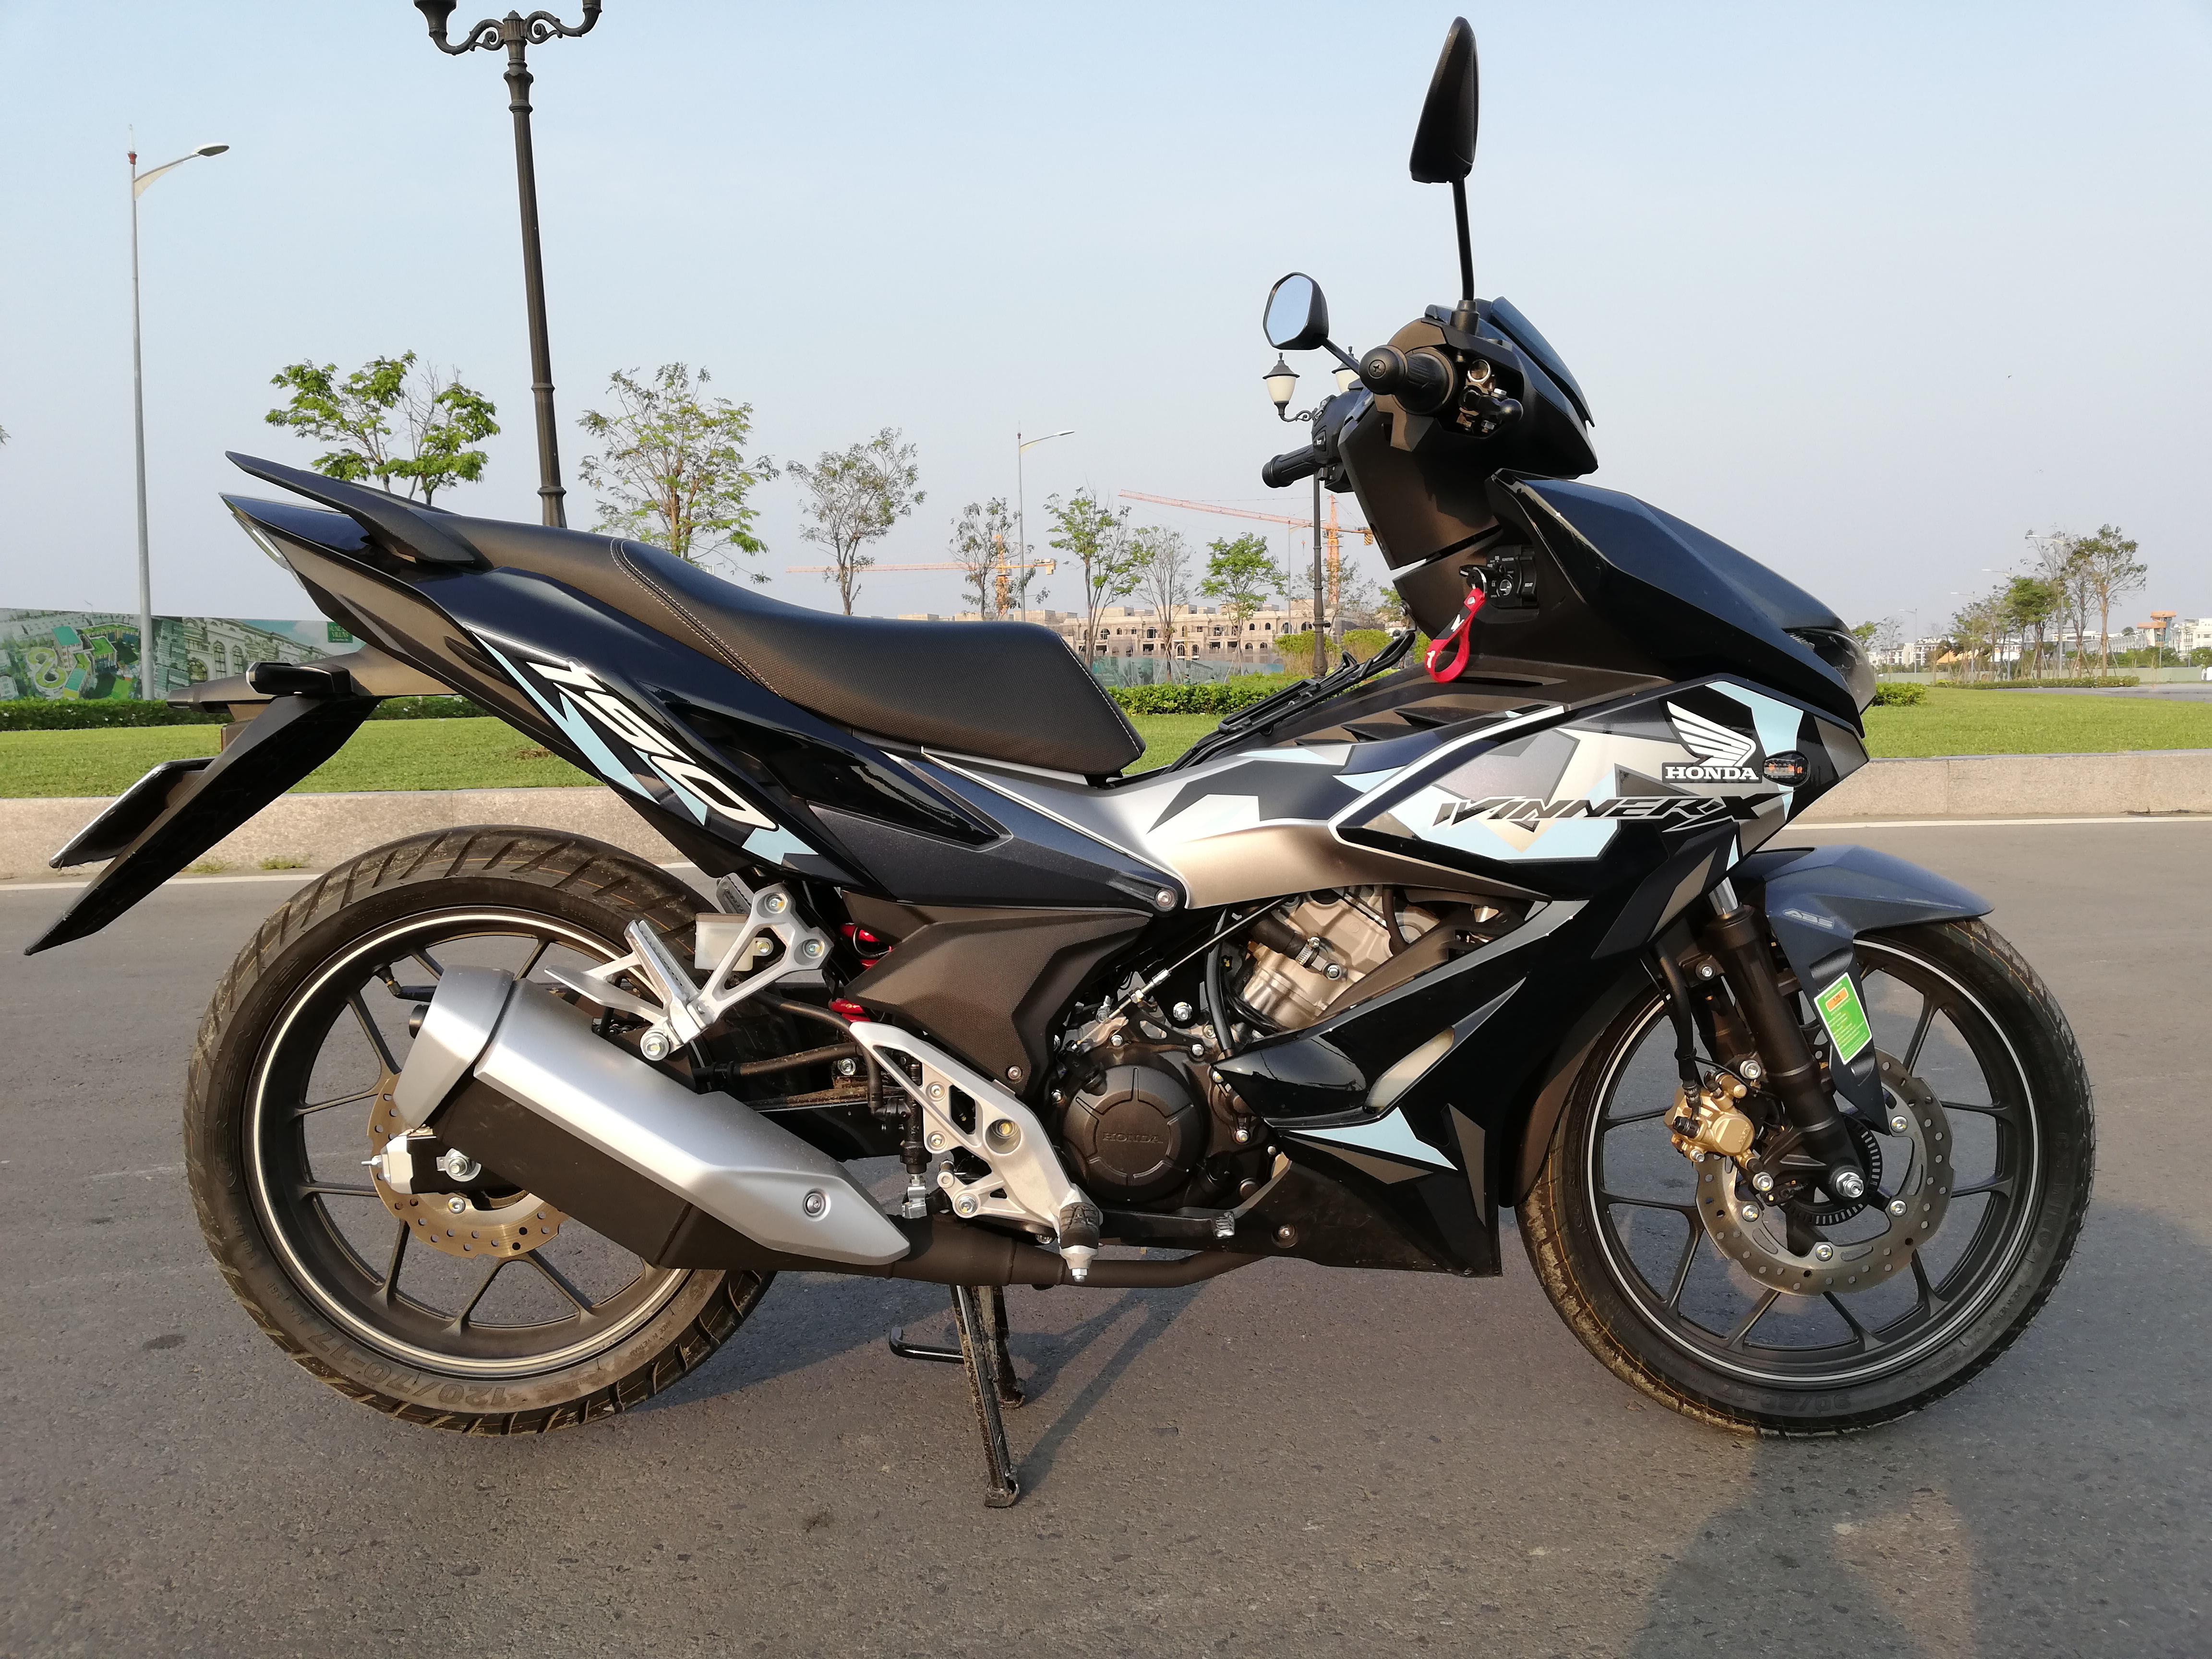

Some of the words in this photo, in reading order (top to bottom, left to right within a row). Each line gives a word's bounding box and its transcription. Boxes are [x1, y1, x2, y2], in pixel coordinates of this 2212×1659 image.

[526, 660, 779, 831] 150
[1665, 766, 1759, 781] HONDA
[1784, 909, 1834, 928] ABS
[1103, 1132, 1164, 1144] HONDA
[308, 1331, 506, 1407] 120/70-17
